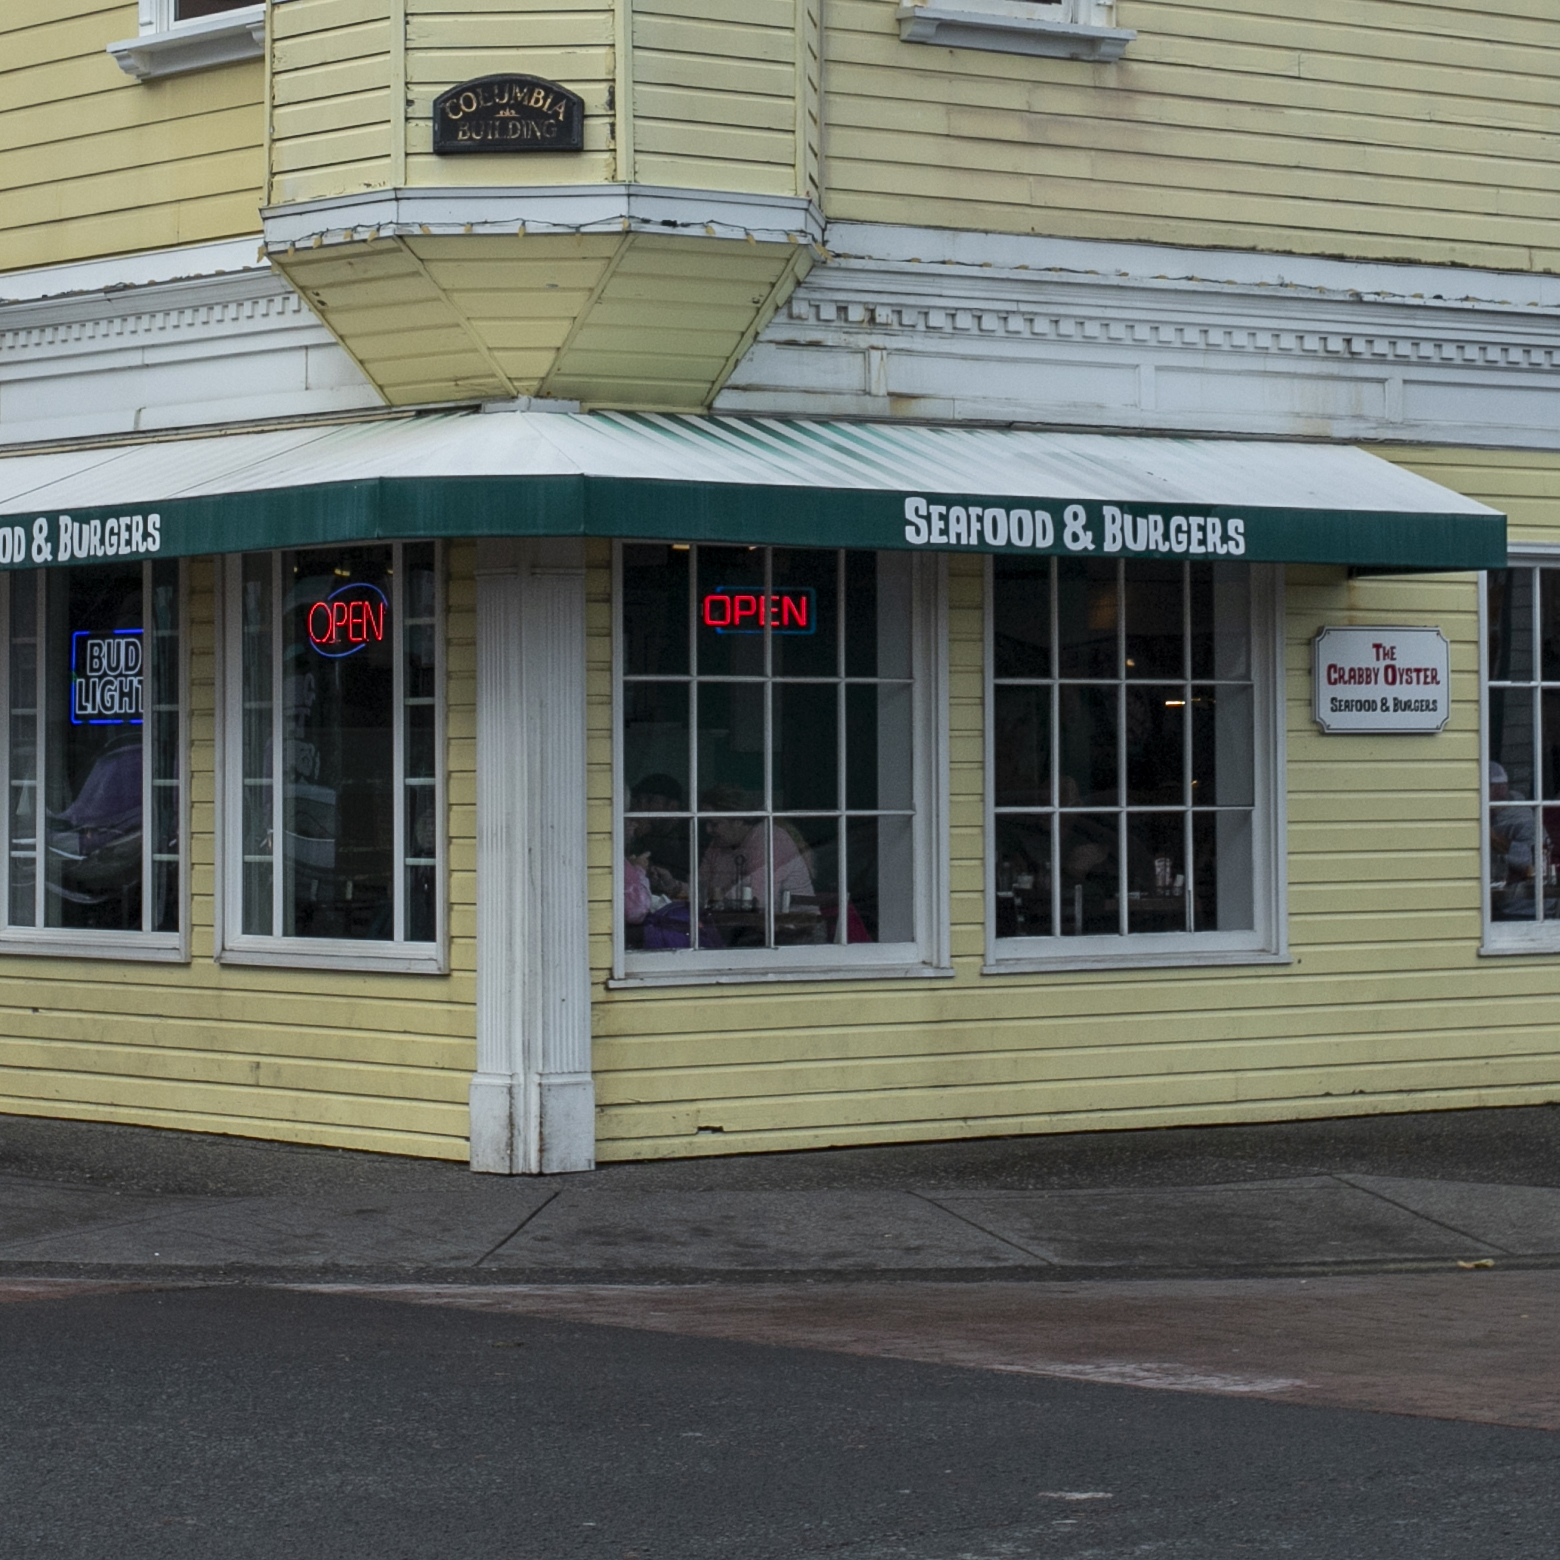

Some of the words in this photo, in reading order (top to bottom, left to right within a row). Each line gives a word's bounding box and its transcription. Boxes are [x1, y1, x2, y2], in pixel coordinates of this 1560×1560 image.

[444, 83, 567, 121] COLUMBIA
[457, 119, 557, 140] BUILDING
[31, 517, 53, 563] &
[904, 496, 1055, 549] SEAFOOD
[1063, 504, 1096, 551] &
[308, 601, 385, 644] OPEN
[703, 594, 808, 628] OPEN
[86, 638, 142, 676] BUD
[1380, 696, 1390, 713] &
